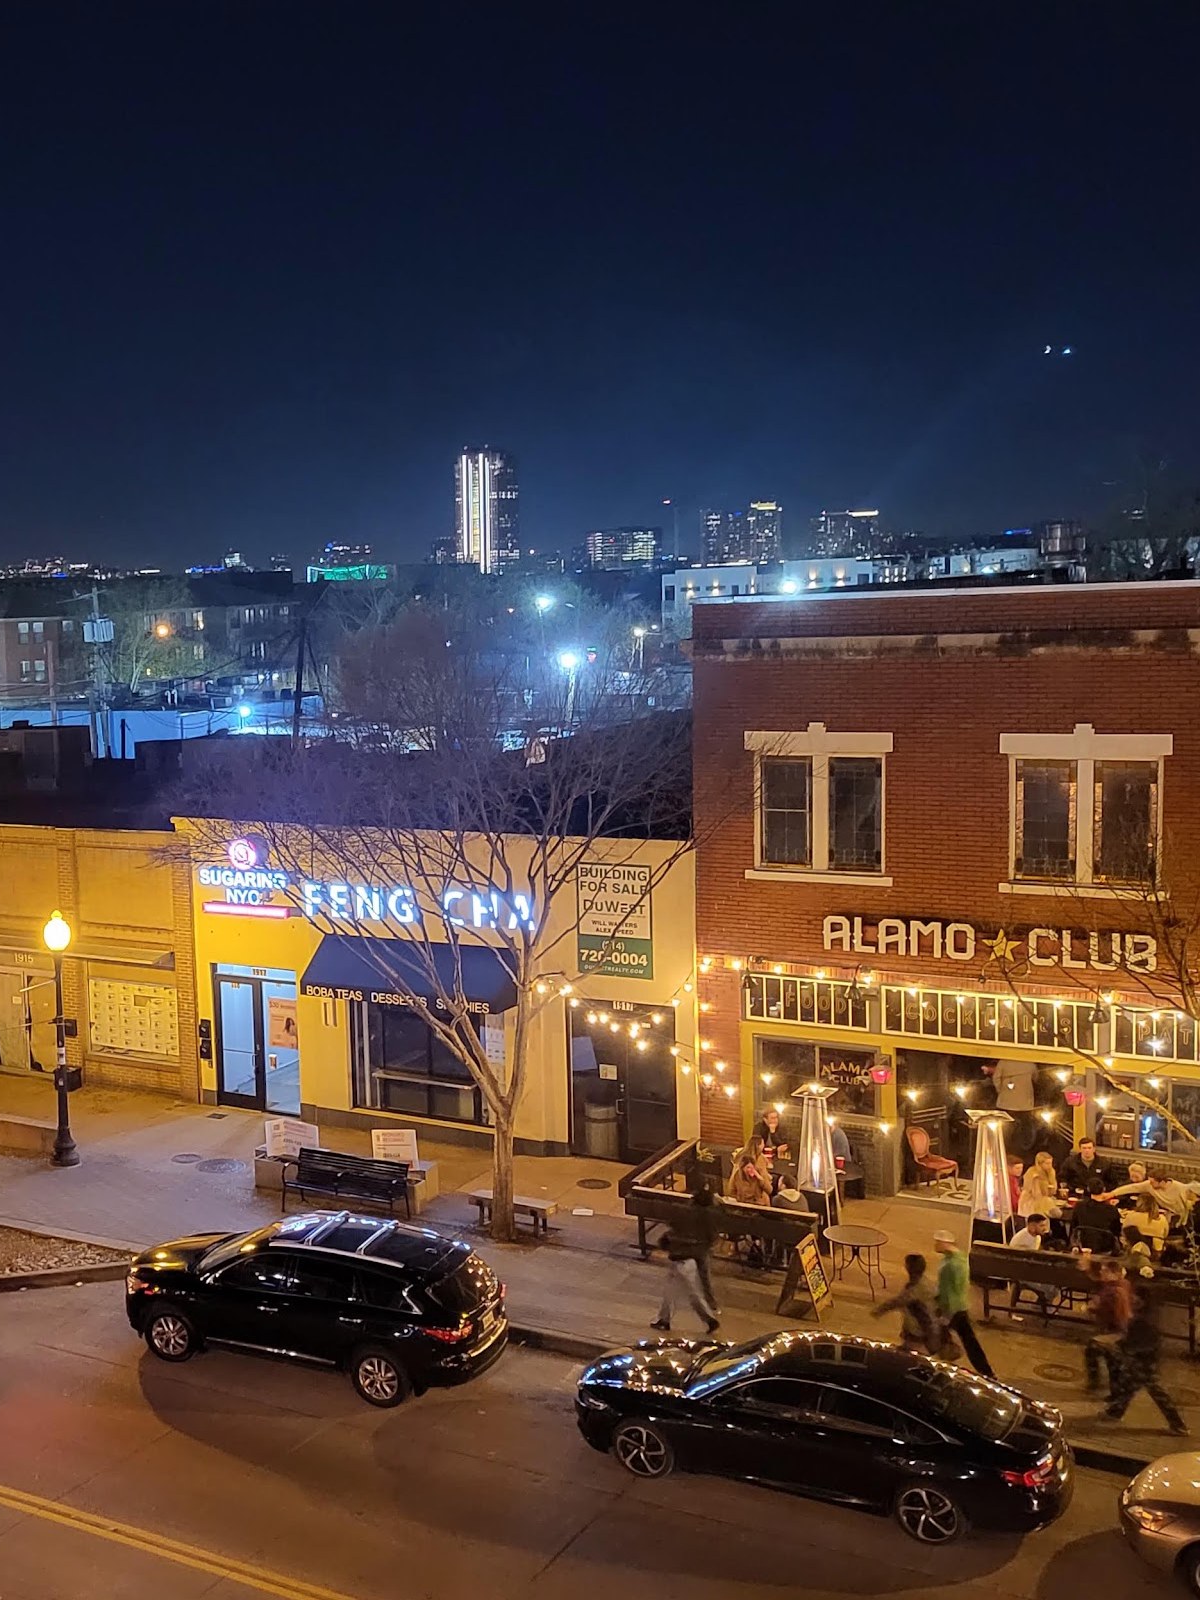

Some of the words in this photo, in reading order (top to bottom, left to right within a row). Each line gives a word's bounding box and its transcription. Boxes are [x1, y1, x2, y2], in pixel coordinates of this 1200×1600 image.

[199, 868, 287, 890] SUGARING
[579, 867, 648, 881] BUILDING
[579, 881, 608, 892] FOR
[612, 883, 648, 895] SALE
[303, 884, 414, 923] FENG
[443, 891, 536, 931] CHA
[822, 915, 976, 961] ALAMO
[1028, 927, 1158, 974] CLUB
[14, 952, 34, 963] 1915
[306, 985, 334, 998] BOBA
[334, 989, 363, 1001] TEAS
[785, 990, 848, 1015] FOOD
[821, 1062, 870, 1076] ALAMO
[833, 1074, 860, 1085] CLUB
